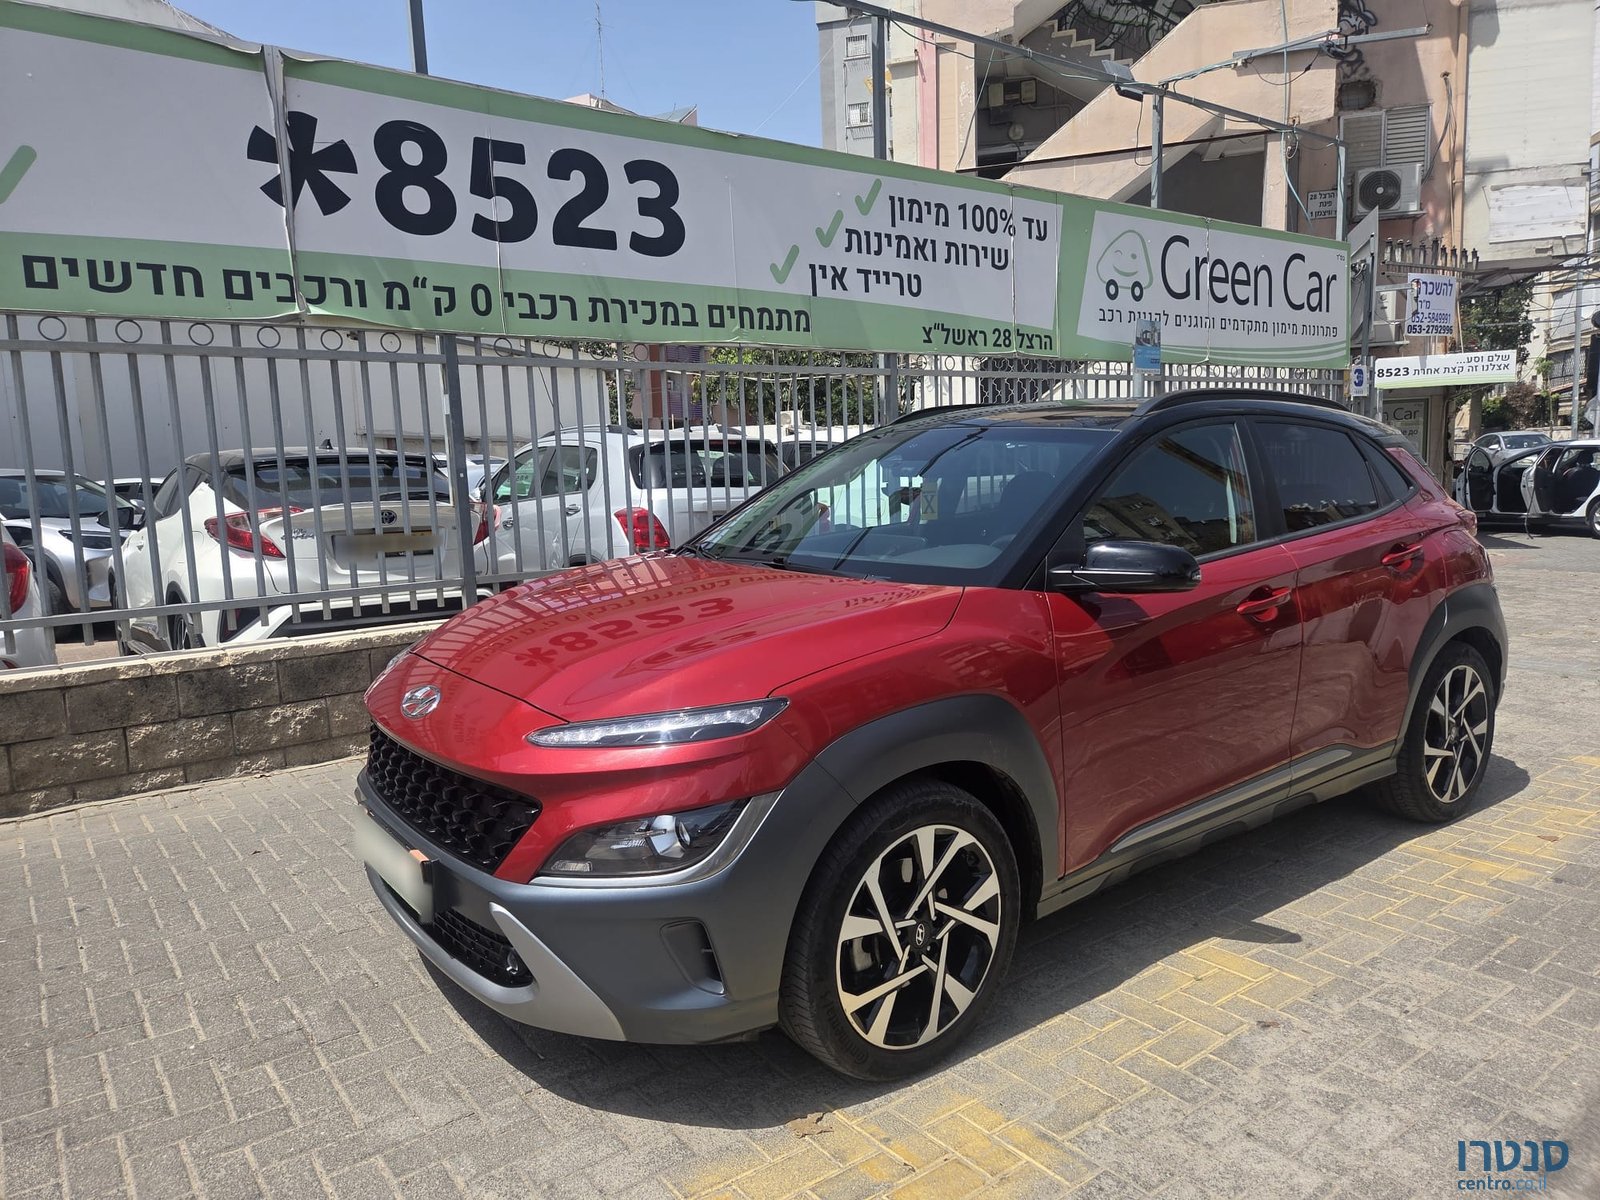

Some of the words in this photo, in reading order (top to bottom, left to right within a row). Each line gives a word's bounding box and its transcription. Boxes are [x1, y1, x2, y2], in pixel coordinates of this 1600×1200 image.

[889, 195, 949, 228] מימון
[958, 202, 1016, 237] 100%
[1022, 216, 1048, 242] עד
[845, 228, 938, 262] ואמינות
[945, 241, 1008, 271] שירות
[22, 254, 205, 298] חדשים
[809, 264, 848, 297] אין
[856, 268, 923, 298] טרייד
[1161, 235, 1272, 308] Green
[1283, 253, 1338, 313] Car
[222, 268, 368, 308] ורכבים
[1418, 279, 1453, 296] להשכר
[471, 283, 492, 317] 0
[503, 291, 578, 322] רכבי
[588, 297, 699, 327] במכירת
[707, 303, 811, 333] מתמחים
[1098, 308, 1123, 323] רכב
[1174, 313, 1216, 330] והוגנים
[922, 322, 987, 347] ראשל"צ
[1220, 317, 1268, 335] מתקדמים
[1272, 322, 1298, 337] מימון
[1301, 324, 1338, 338] פתרונות
[992, 328, 1012, 348] 28
[1016, 329, 1053, 350] הרצל
[1467, 364, 1478, 372] זה
[1481, 363, 1510, 372] אצלנו
[1488, 354, 1510, 363] שלם
[1375, 367, 1410, 378] 8523
[1413, 367, 1440, 376] אחרת
[1443, 366, 1464, 375] קצת
[1393, 407, 1420, 421] Car
